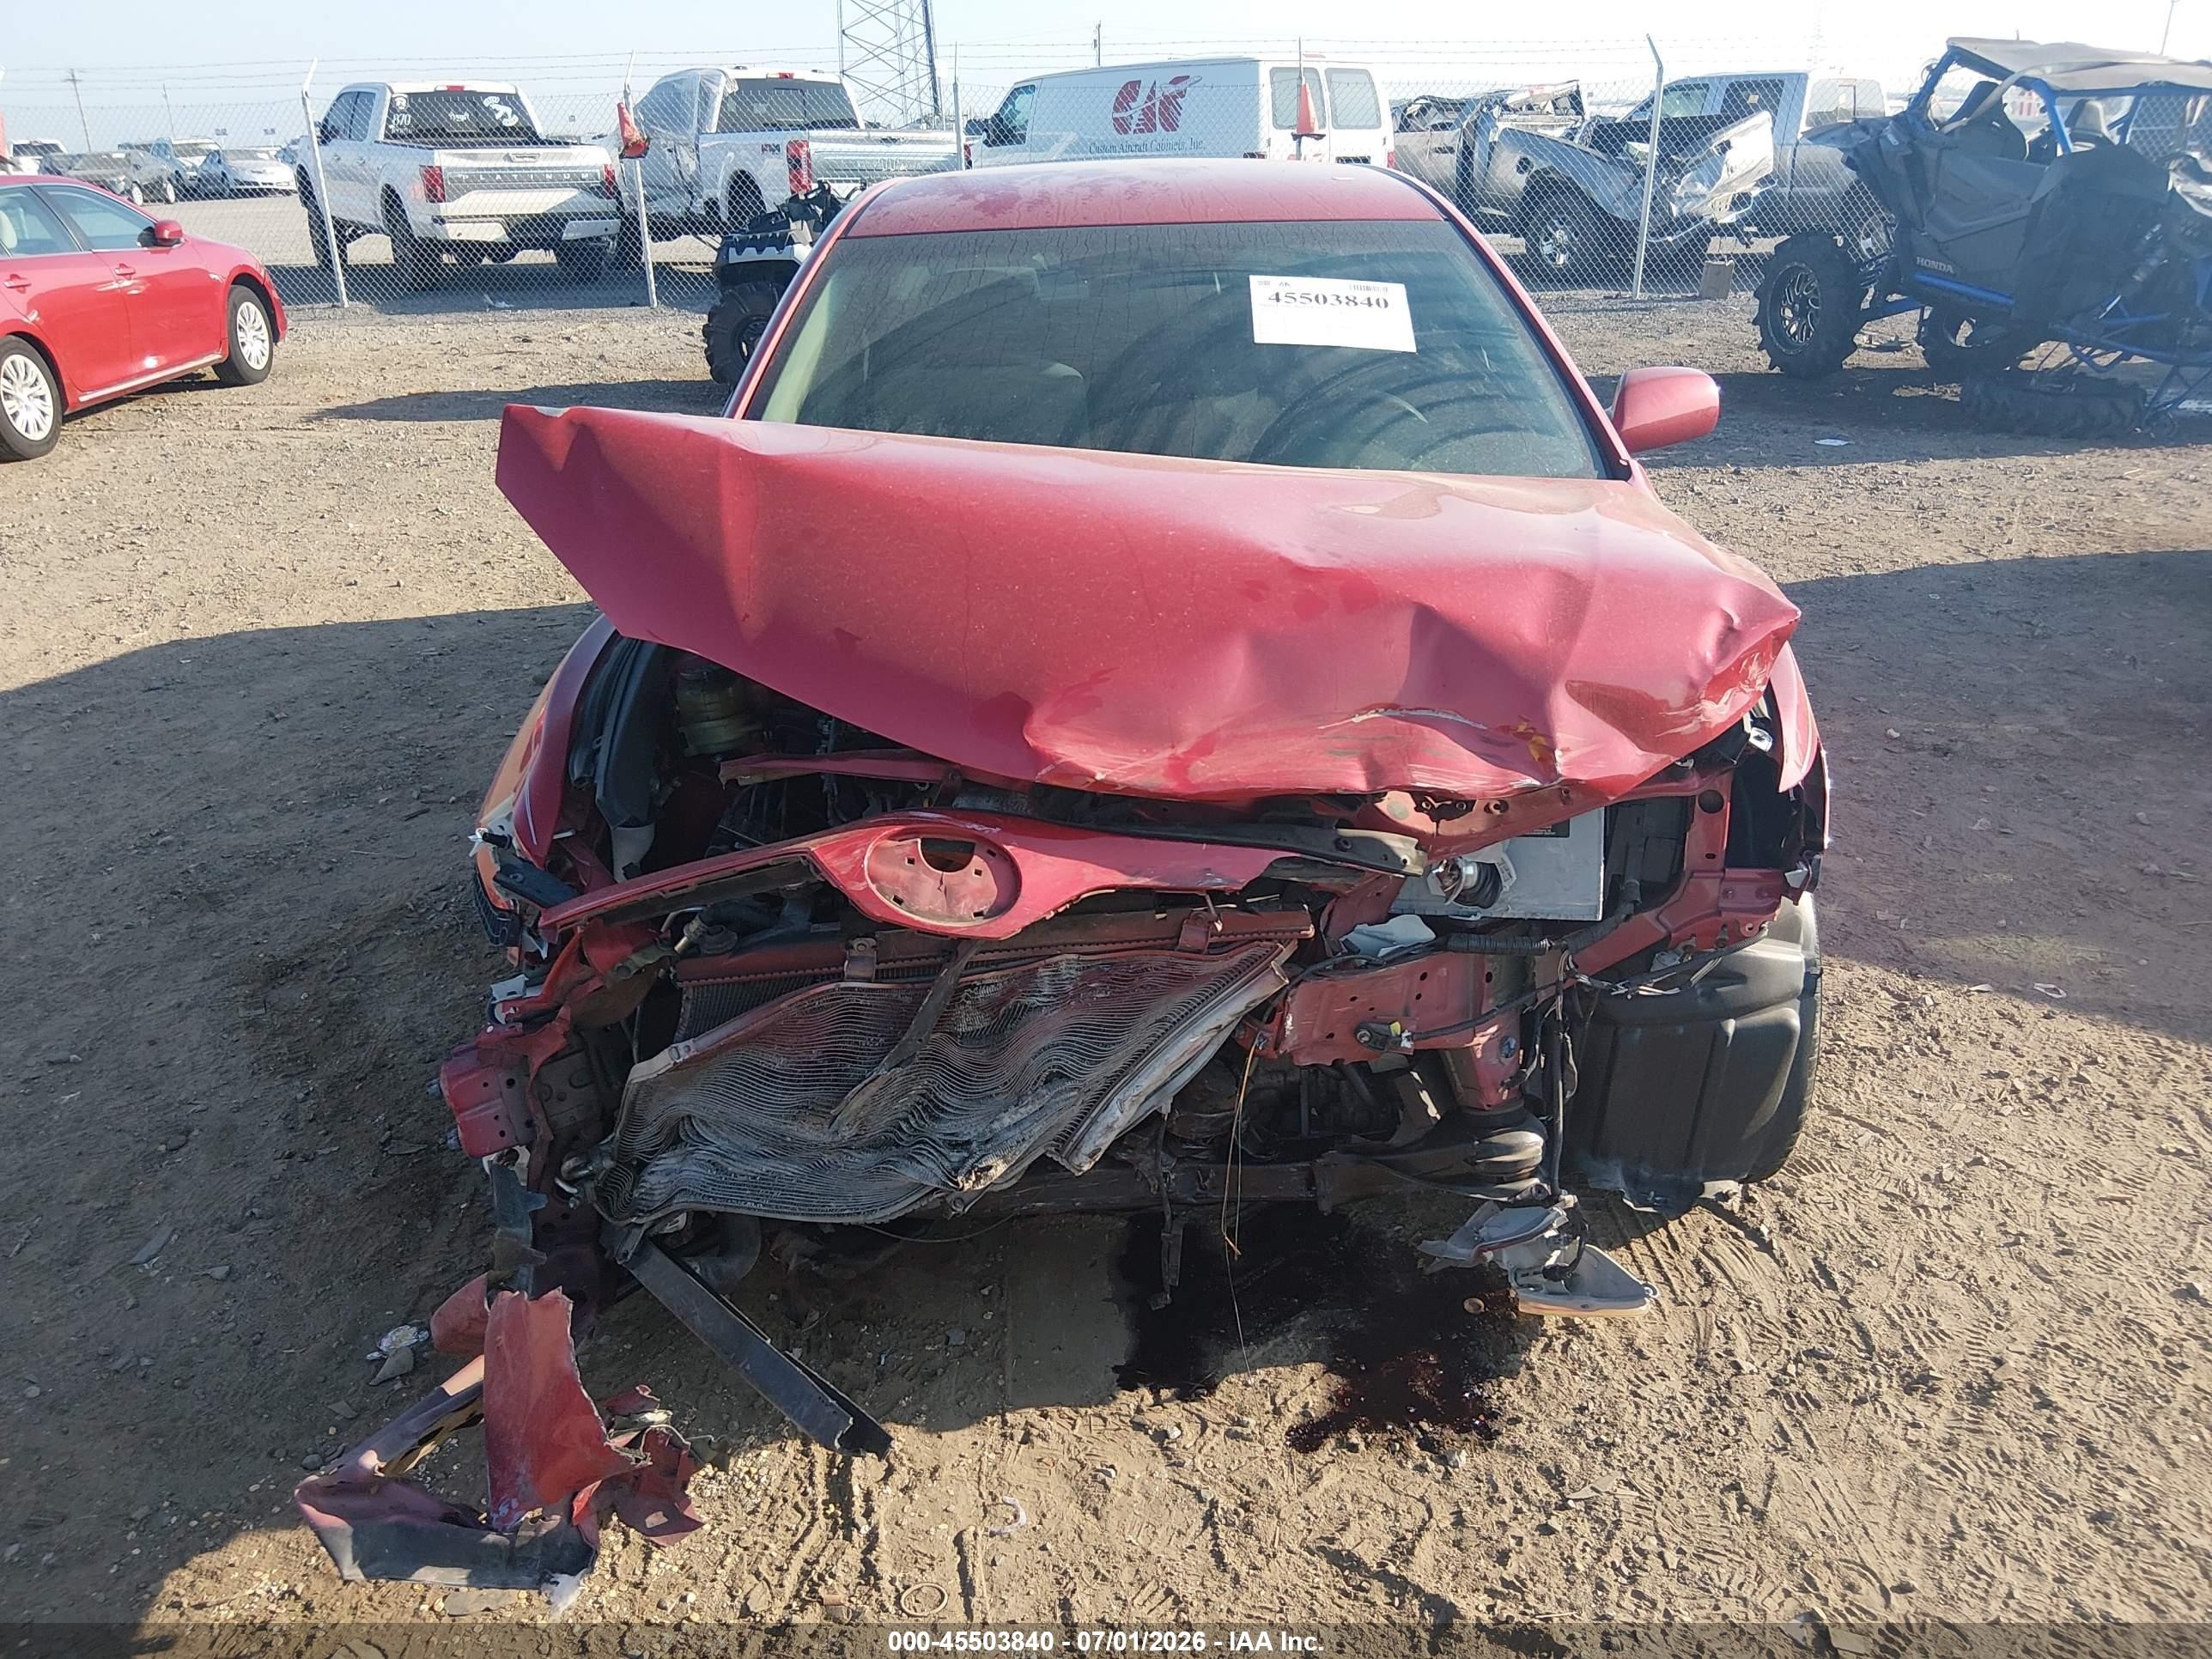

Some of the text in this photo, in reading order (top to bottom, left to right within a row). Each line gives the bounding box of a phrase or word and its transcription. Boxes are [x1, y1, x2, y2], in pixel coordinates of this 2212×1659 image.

[1089, 143, 1116, 155] Custom
[1118, 140, 1148, 153] Aircraft
[1189, 137, 1206, 151] Inc.
[1916, 256, 1955, 274] HONDA
[1267, 291, 1389, 309] 45503840
